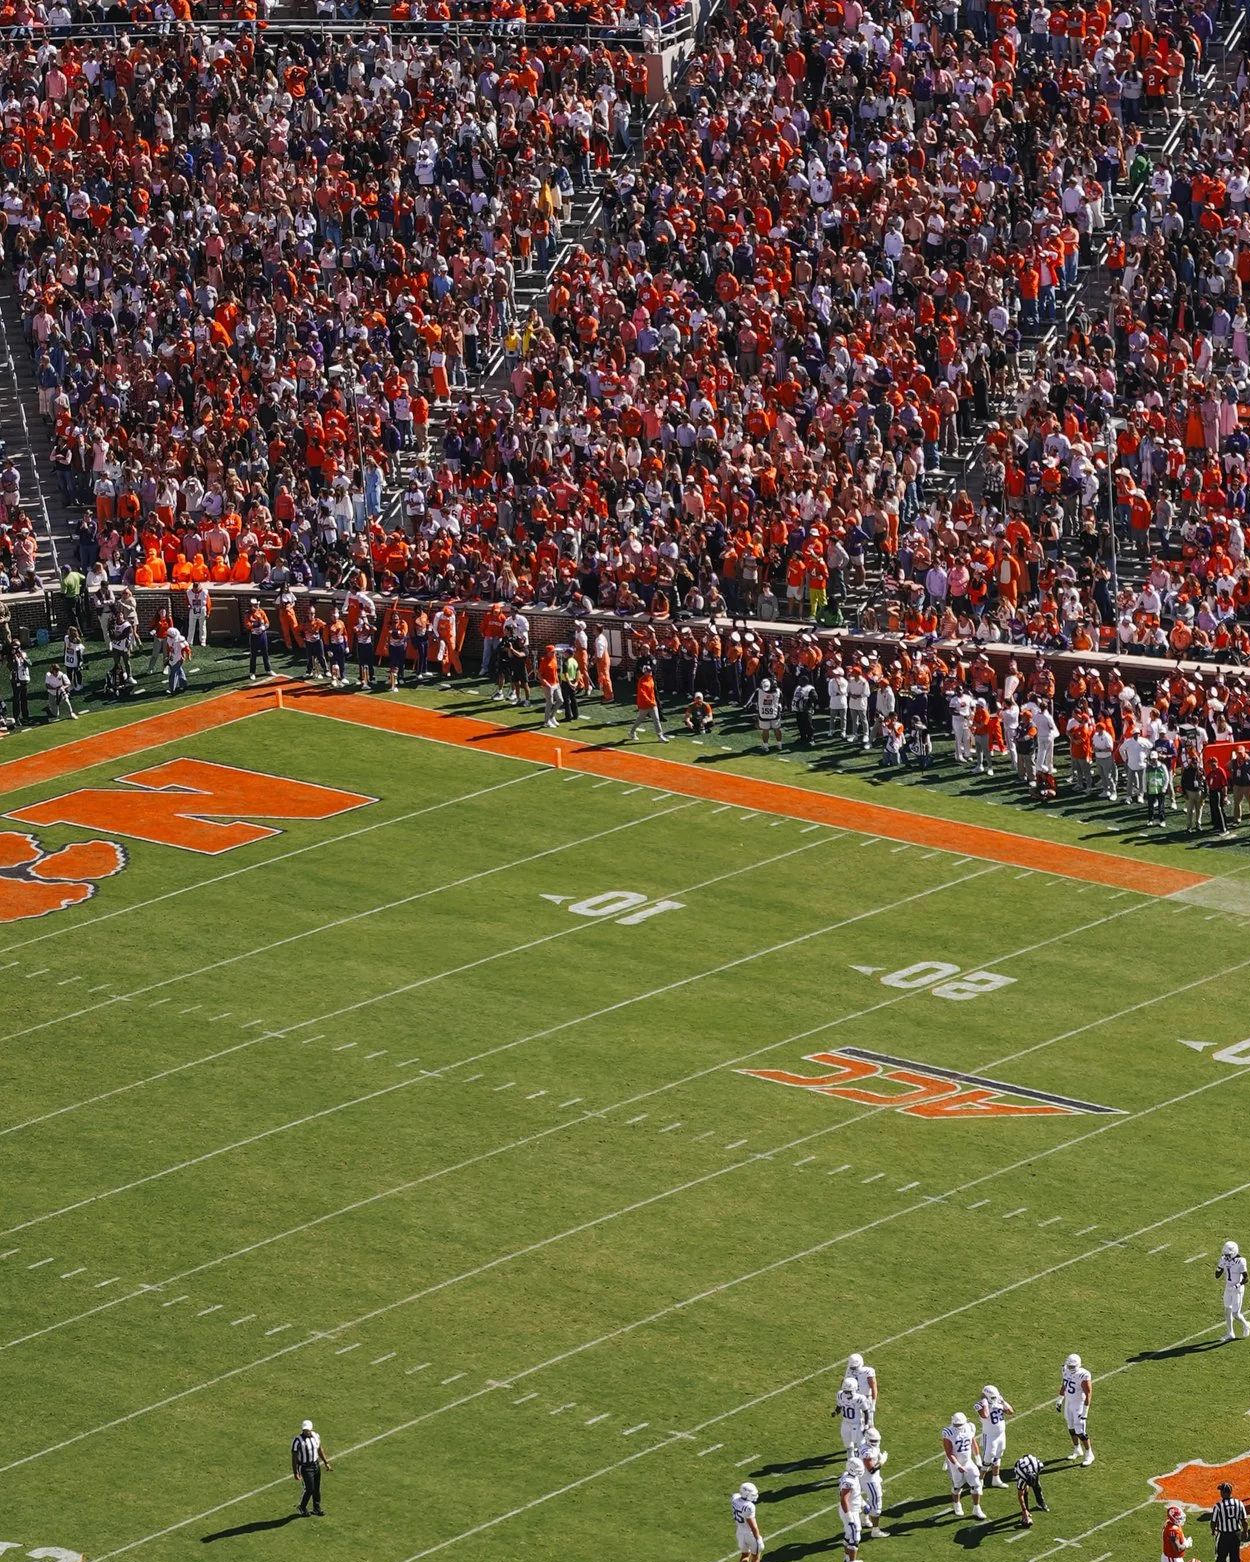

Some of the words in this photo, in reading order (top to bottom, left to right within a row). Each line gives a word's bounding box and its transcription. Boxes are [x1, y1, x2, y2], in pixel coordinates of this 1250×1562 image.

[619, 68, 629, 79] 16
[1147, 76, 1154, 86] 2
[718, 375, 728, 385] 16
[567, 890, 686, 925] 10
[879, 961, 1017, 1000] 20
[1226, 1266, 1231, 1281] 1
[841, 1405, 855, 1420] 10
[1226, 1507, 1234, 1518] U
